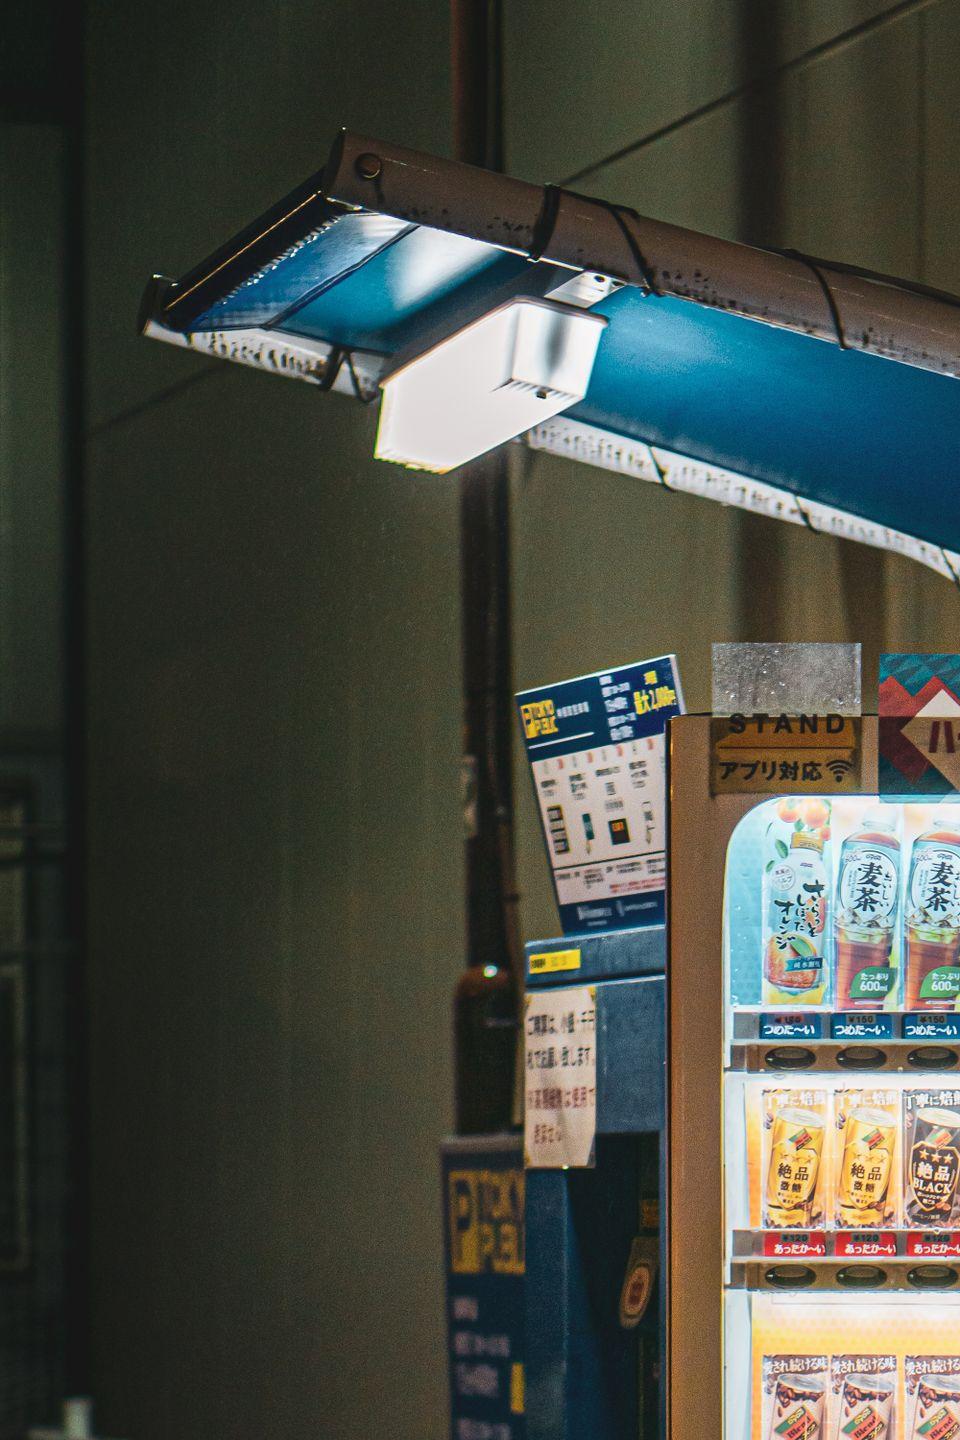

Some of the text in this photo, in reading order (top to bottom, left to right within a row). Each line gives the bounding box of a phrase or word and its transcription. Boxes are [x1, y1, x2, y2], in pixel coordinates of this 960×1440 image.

[729, 713, 845, 734] STAND
[719, 760, 822, 781] アプリ対応
[853, 862, 883, 912] 麦茶
[925, 862, 954, 912] 麦茶
[860, 973, 889, 981] たっぷり
[931, 973, 960, 981] たっぷり
[777, 1163, 809, 1181] 絶品
[850, 1163, 882, 1181] 絶品
[917, 1162, 949, 1182] 絶品
[913, 1177, 952, 1194] BLACK
[930, 1417, 955, 1439] Blend
